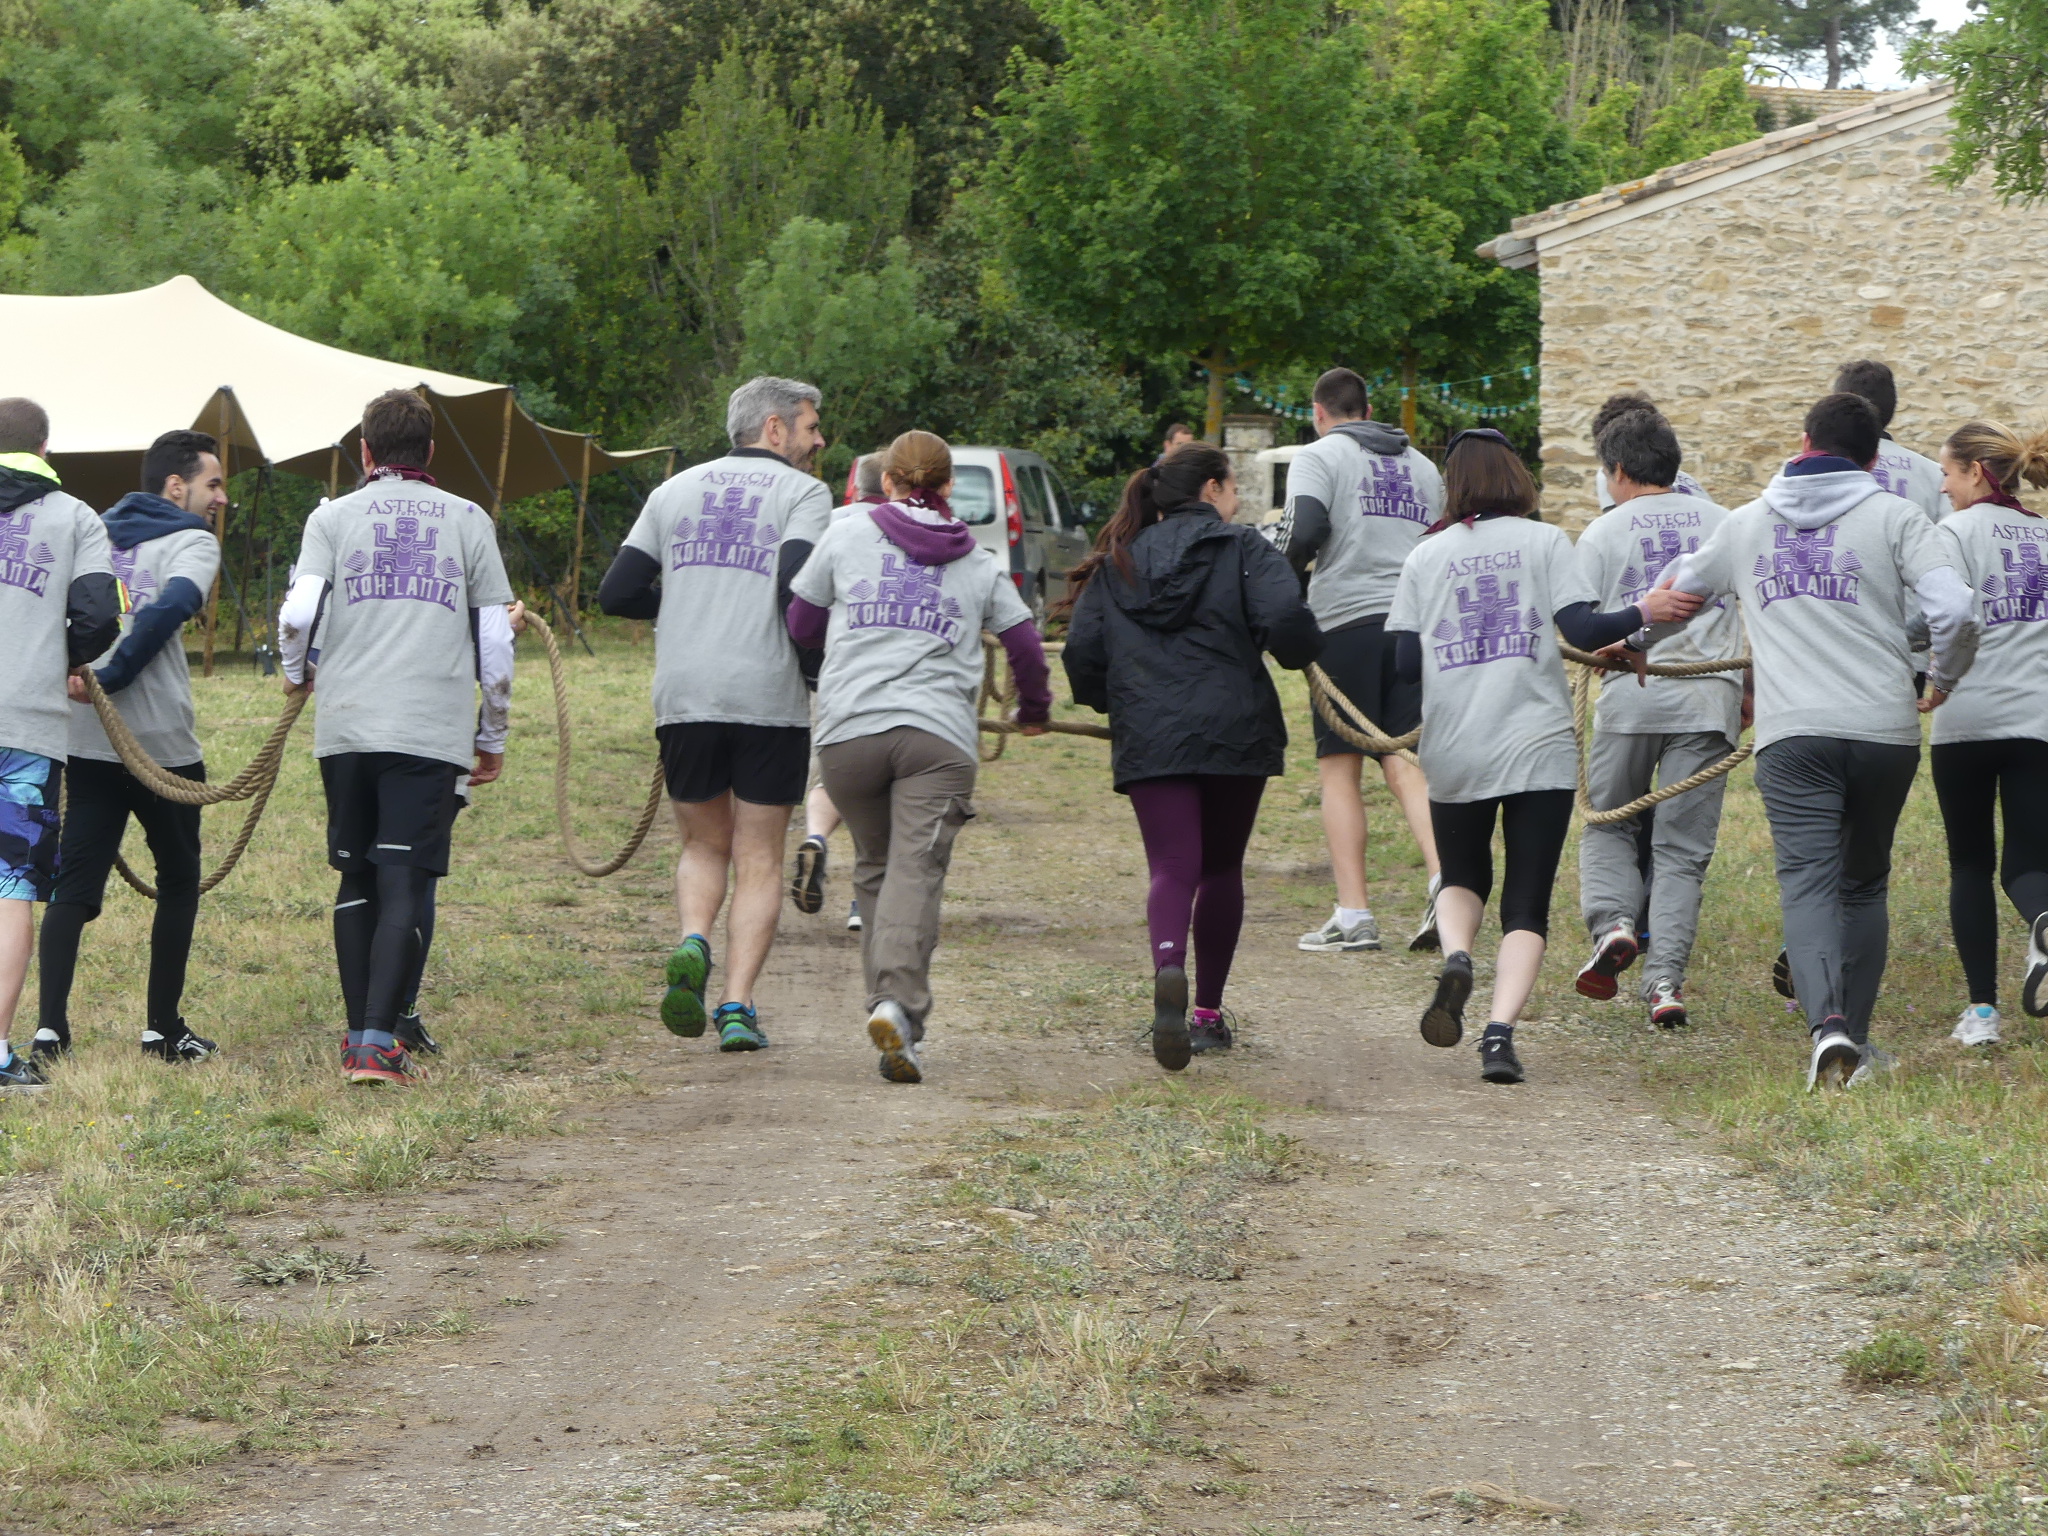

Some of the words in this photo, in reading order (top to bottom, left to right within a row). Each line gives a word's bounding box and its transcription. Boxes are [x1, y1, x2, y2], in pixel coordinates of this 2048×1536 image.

[1361, 496, 1432, 524] KOH-LANTA
[673, 542, 772, 573] KOH-LANTA
[347, 575, 458, 607] KOH-LANTA
[1757, 573, 1858, 606] KOH-LANTA
[848, 603, 958, 641] KOH-LANTA
